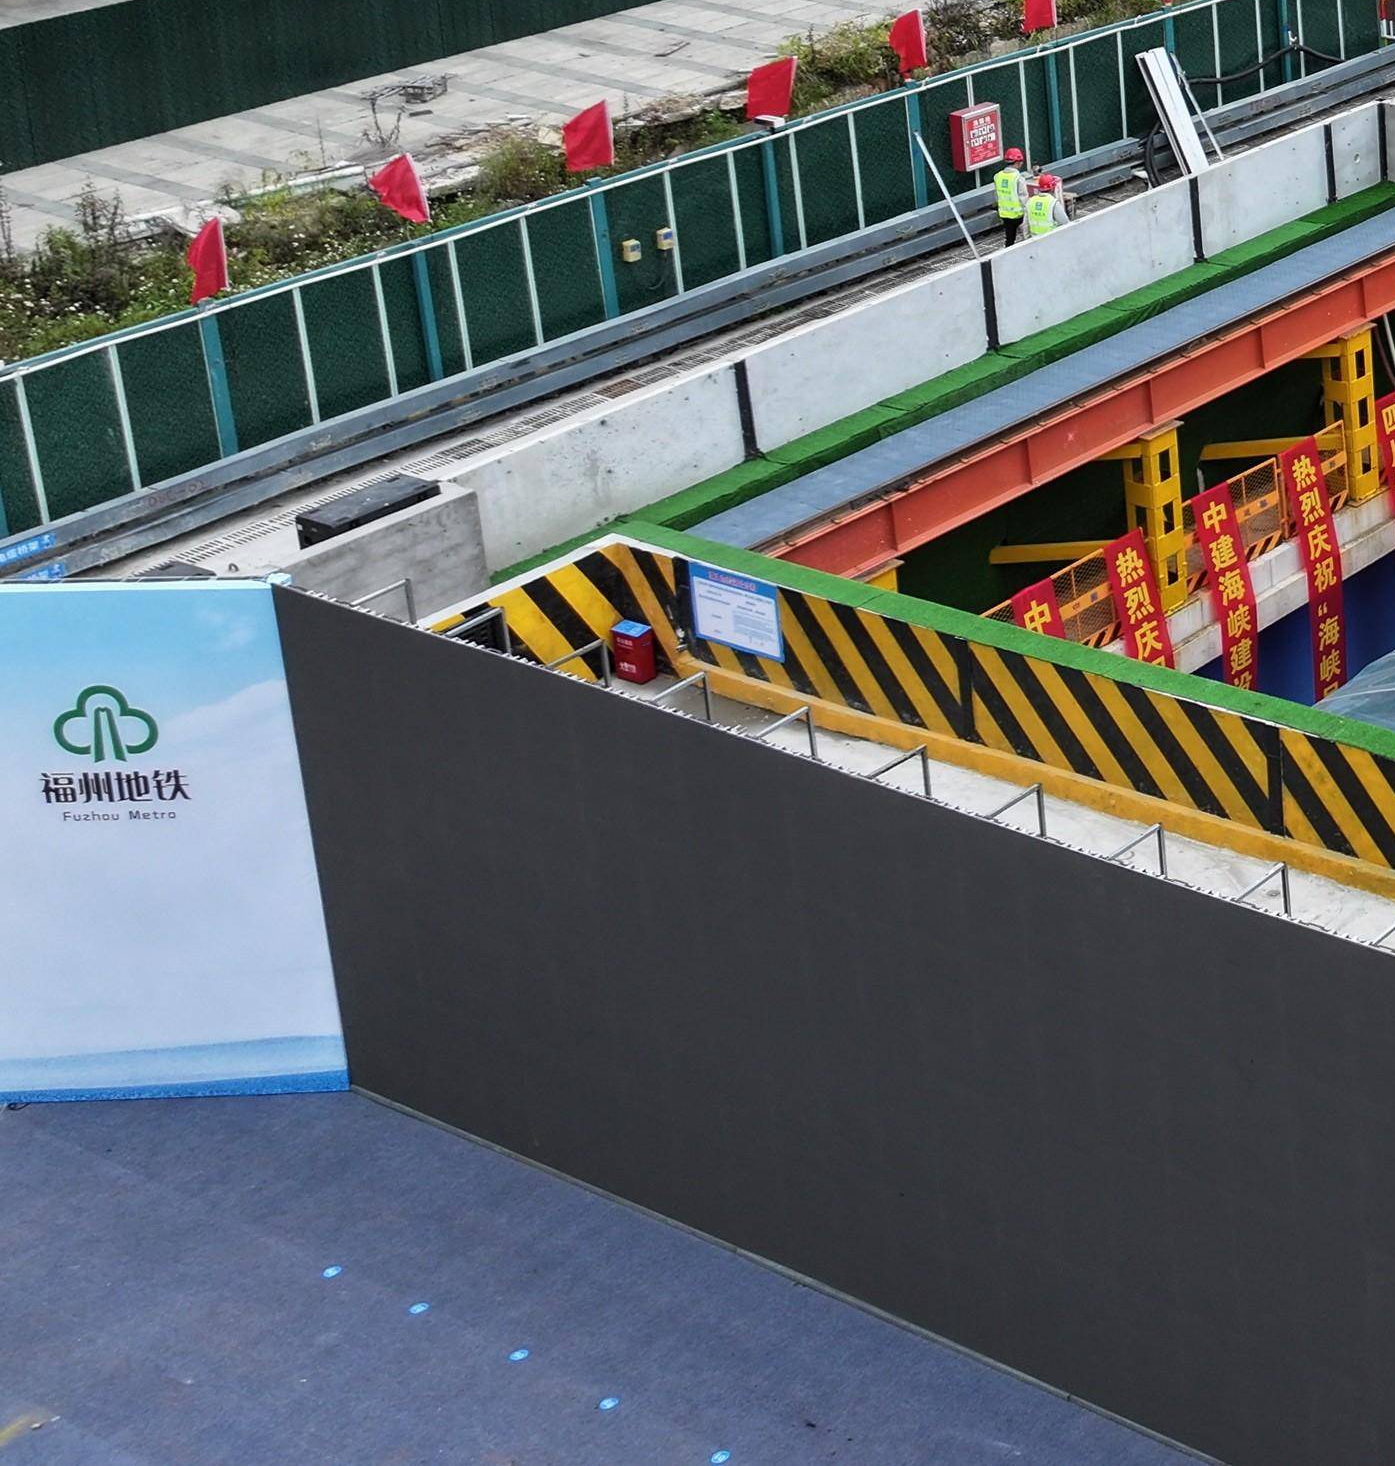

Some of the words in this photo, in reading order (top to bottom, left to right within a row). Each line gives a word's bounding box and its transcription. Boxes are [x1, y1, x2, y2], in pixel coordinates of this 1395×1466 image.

[41, 769, 192, 805] 福州地铁
[62, 810, 120, 823] Fuzhou
[129, 809, 177, 821] Metro
